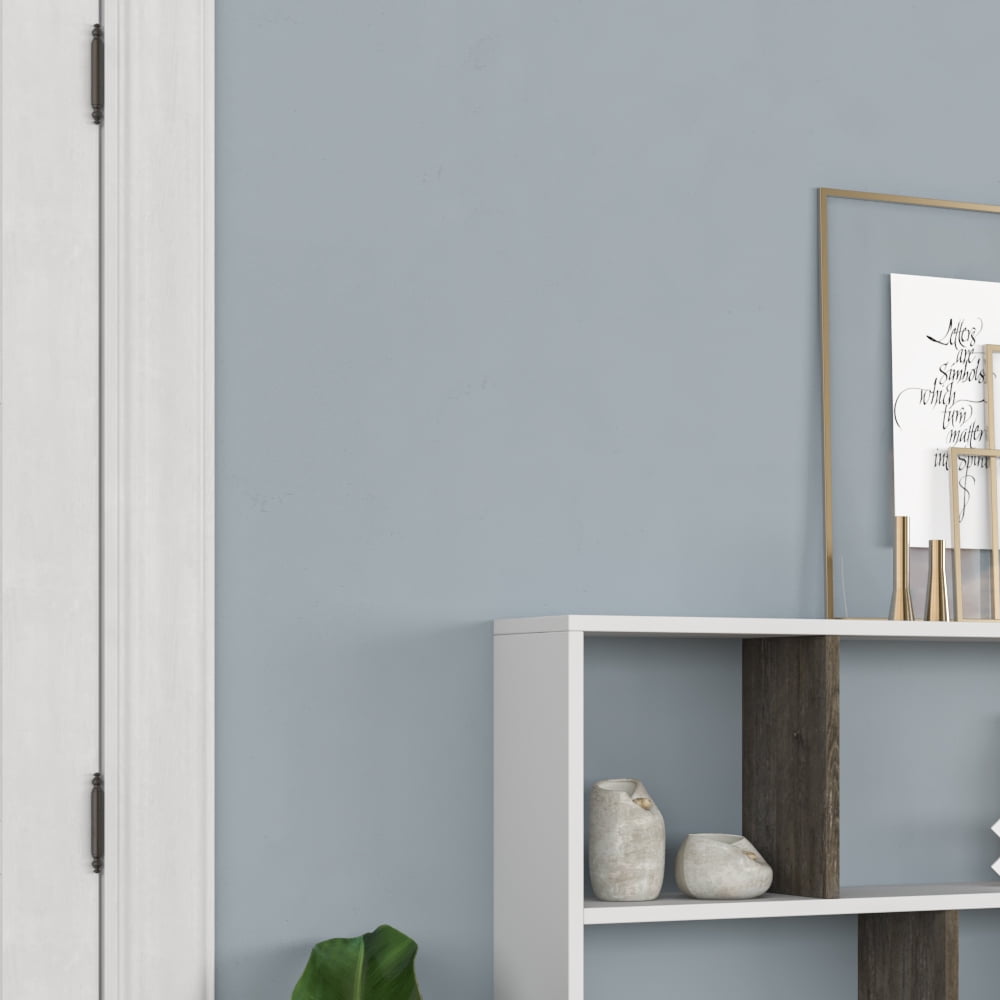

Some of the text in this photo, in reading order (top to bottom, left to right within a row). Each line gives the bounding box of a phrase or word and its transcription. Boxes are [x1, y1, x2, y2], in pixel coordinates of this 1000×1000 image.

[926, 317, 983, 350] Letters
[955, 348, 976, 364] are
[941, 404, 972, 430] turn
[946, 422, 985, 448] matter
